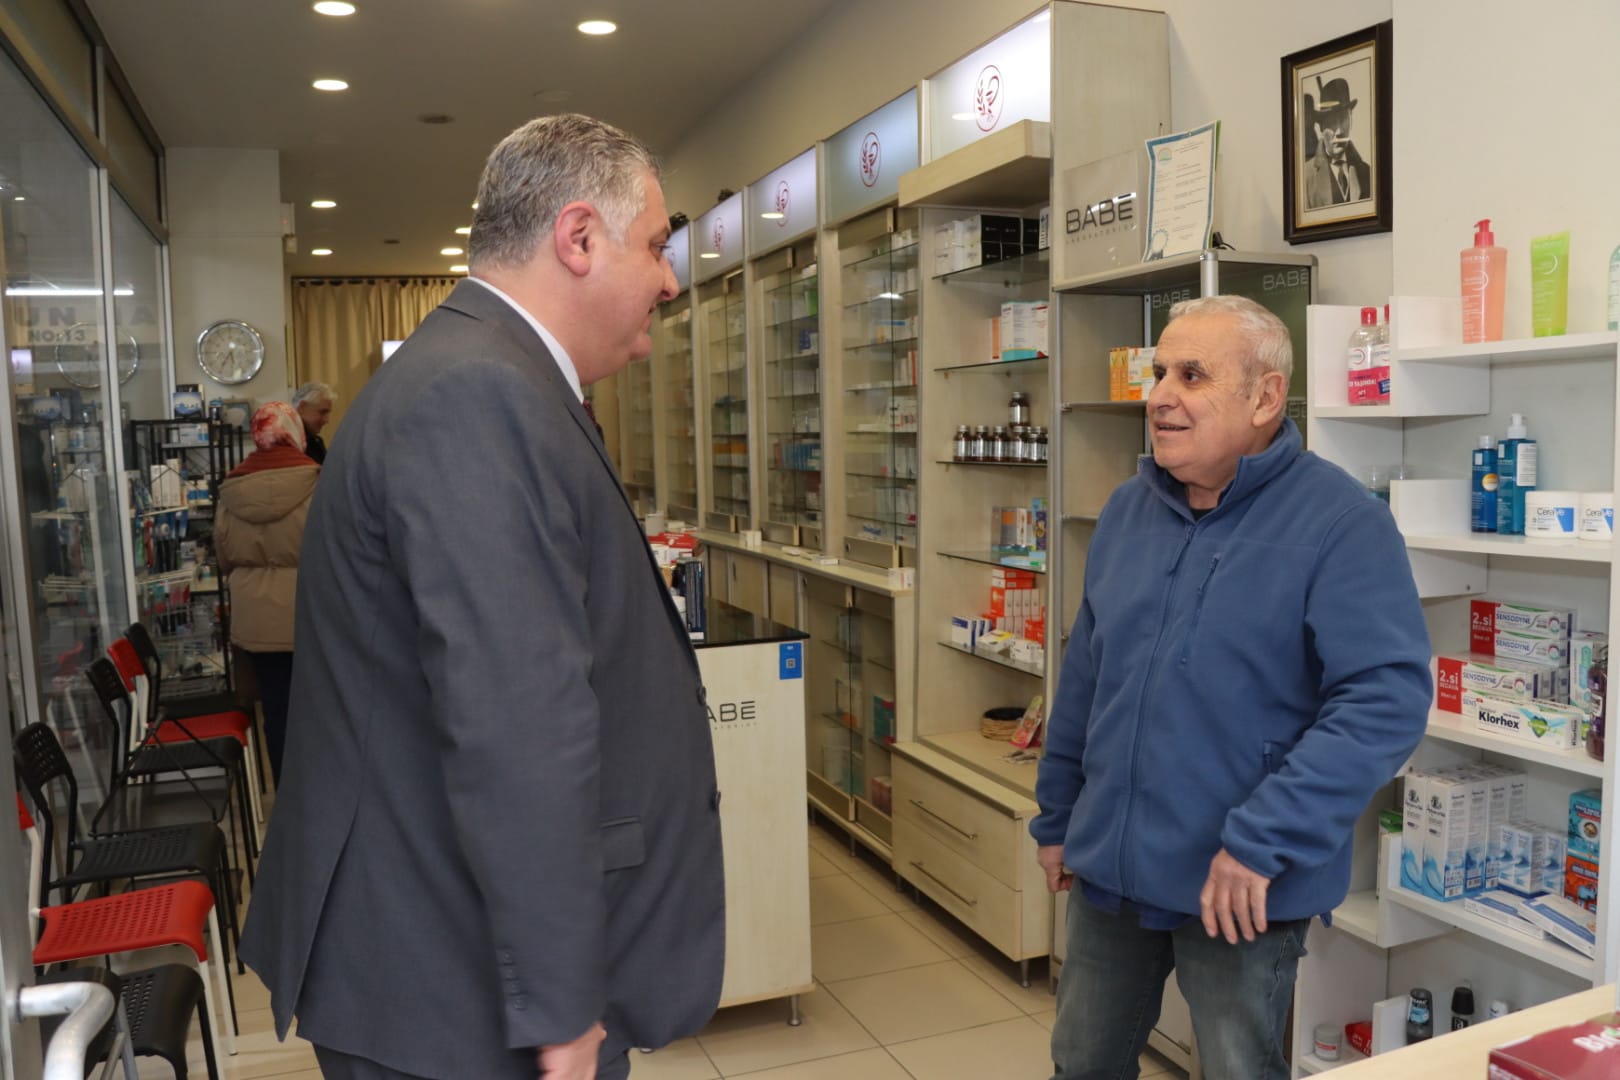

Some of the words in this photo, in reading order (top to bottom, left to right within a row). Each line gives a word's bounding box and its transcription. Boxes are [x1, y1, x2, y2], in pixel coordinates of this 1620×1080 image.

[1496, 613, 1531, 625] SENSODYNE
[1495, 639, 1530, 652] SENSODYNE
[1463, 671, 1497, 684] SENSODYNE
[1478, 711, 1520, 730] Klorhex
